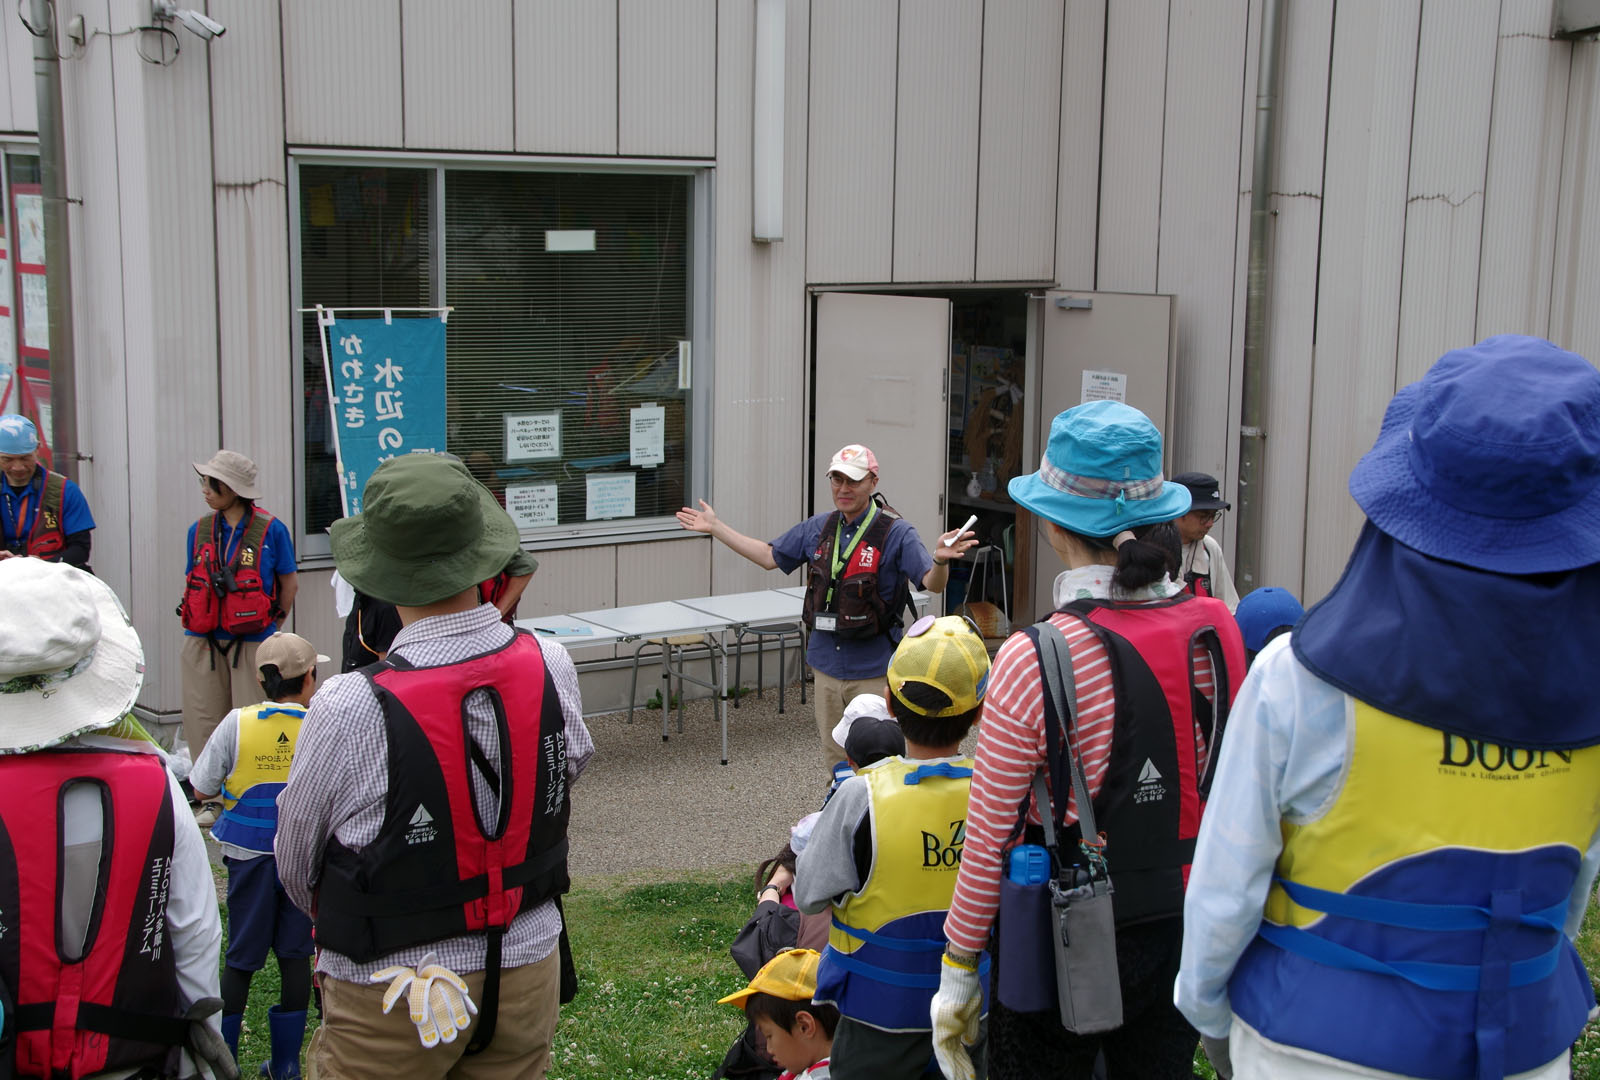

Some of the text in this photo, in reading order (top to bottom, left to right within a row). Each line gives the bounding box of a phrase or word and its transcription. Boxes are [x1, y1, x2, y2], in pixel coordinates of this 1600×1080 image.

[241, 552, 254, 562] 75
[860, 552, 873, 563] 75
[544, 734, 557, 815] エコミュージアム
[1480, 772, 1519, 781] Lifejacket
[140, 858, 163, 954] エコミュージアム
